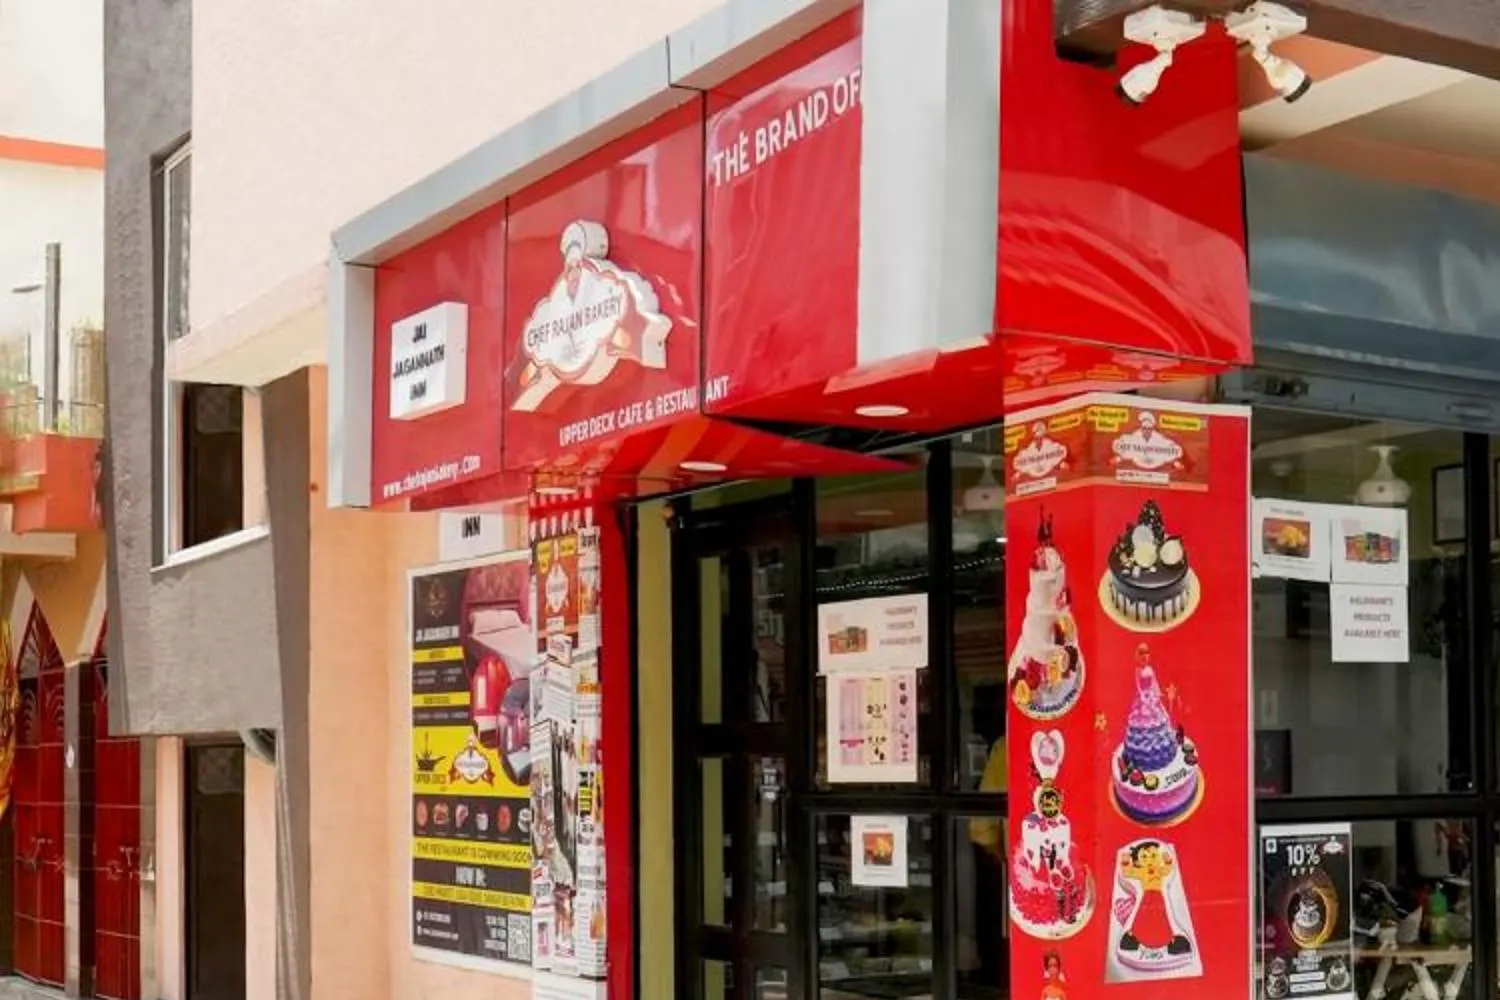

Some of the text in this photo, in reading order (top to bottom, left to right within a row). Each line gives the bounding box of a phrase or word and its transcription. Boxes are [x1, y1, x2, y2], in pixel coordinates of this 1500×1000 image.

[712, 69, 861, 187] THE BRAND OF
[527, 295, 622, 348] CHEF RAJAN BAKERY
[559, 421, 589, 447] UPPER
[589, 412, 615, 439] DECK
[617, 402, 644, 429] CAFE
[645, 399, 655, 421] &
[462, 515, 481, 539] INN
[1286, 843, 1321, 867] 10%
